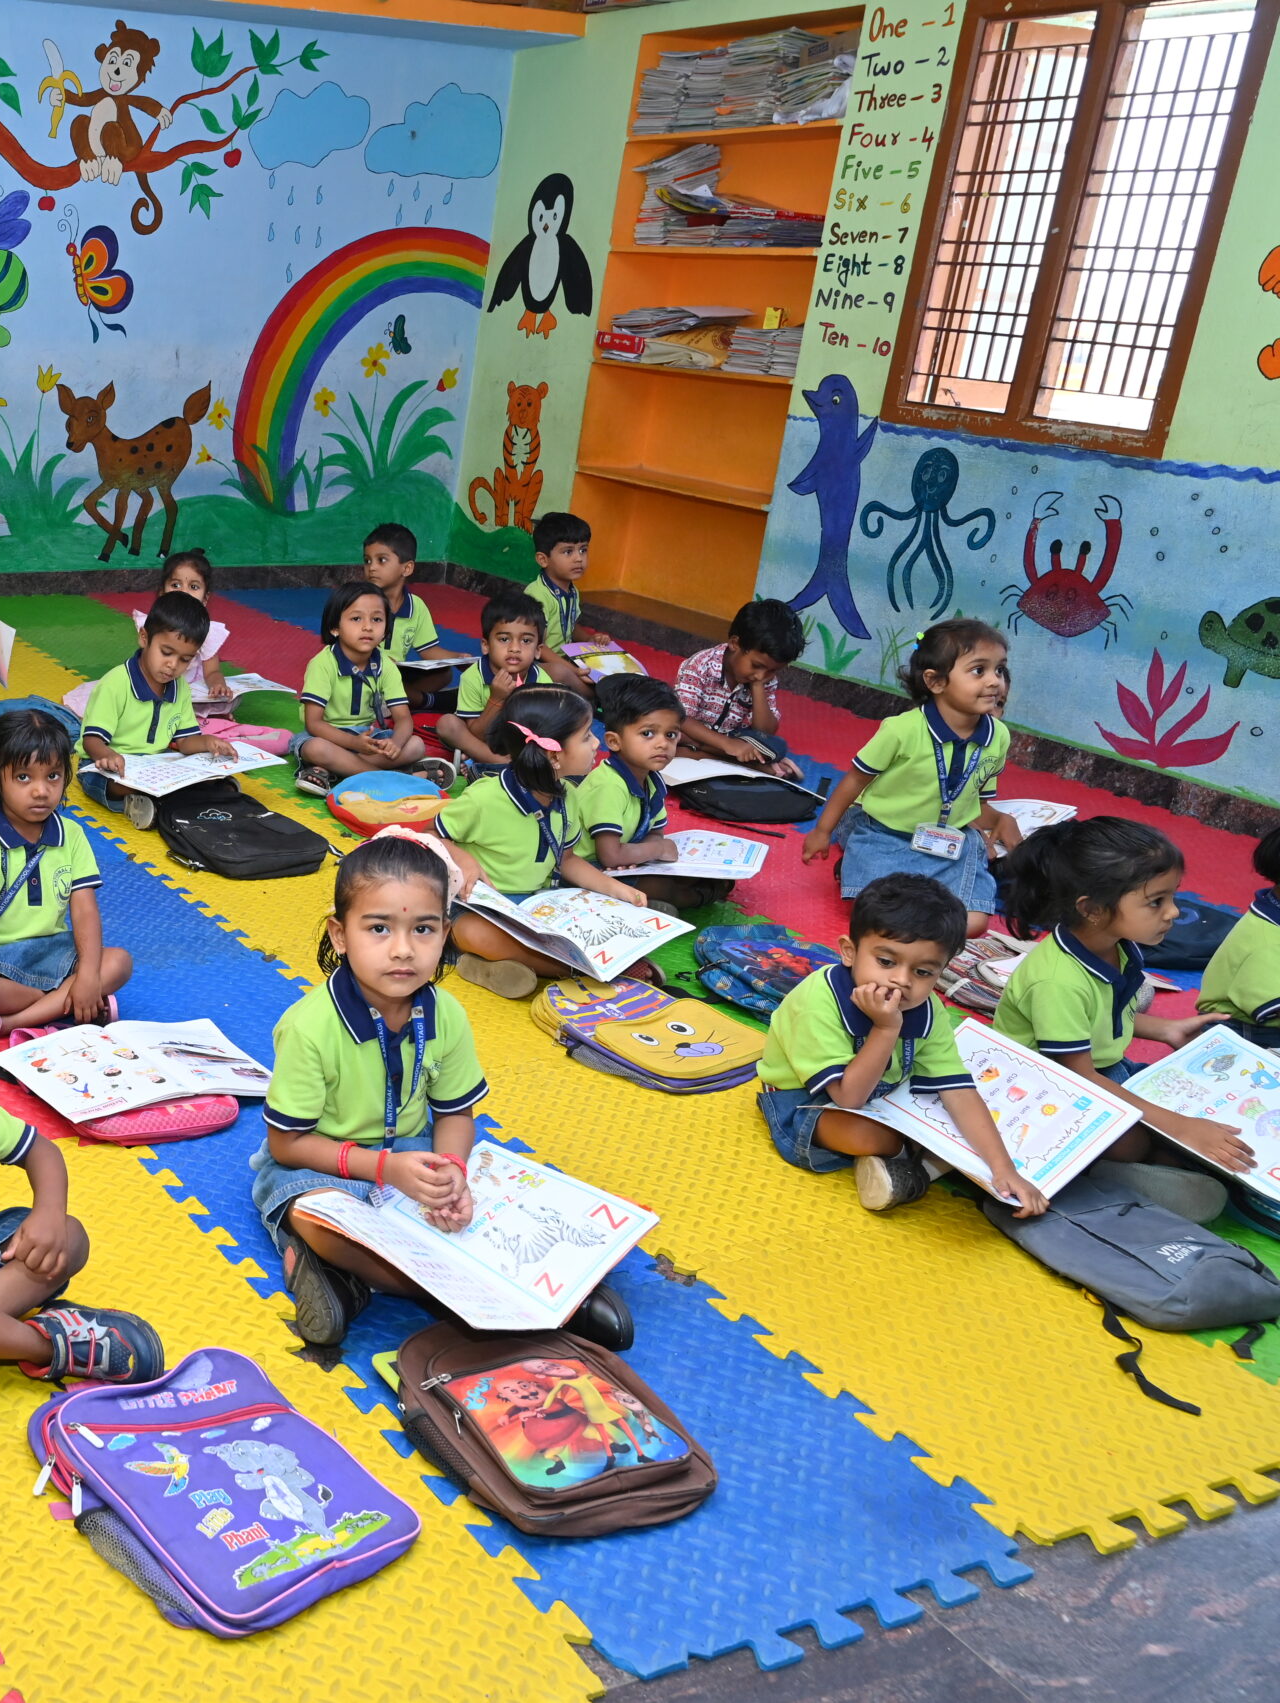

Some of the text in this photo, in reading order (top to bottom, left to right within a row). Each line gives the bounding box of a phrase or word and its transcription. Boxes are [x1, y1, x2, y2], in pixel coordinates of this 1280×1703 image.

[870, 7, 908, 42] One
[862, 52, 905, 77] Two
[854, 84, 907, 112] Three
[848, 123, 901, 148] Four
[841, 155, 884, 181] Five
[833, 188, 868, 212] Six
[829, 222, 879, 246] Seven
[823, 252, 872, 288] Eight
[815, 288, 865, 310] Nine
[819, 321, 849, 348] Ten
[14, 869, 30, 889] SCHOOL
[220, 1522, 270, 1551] Phant
